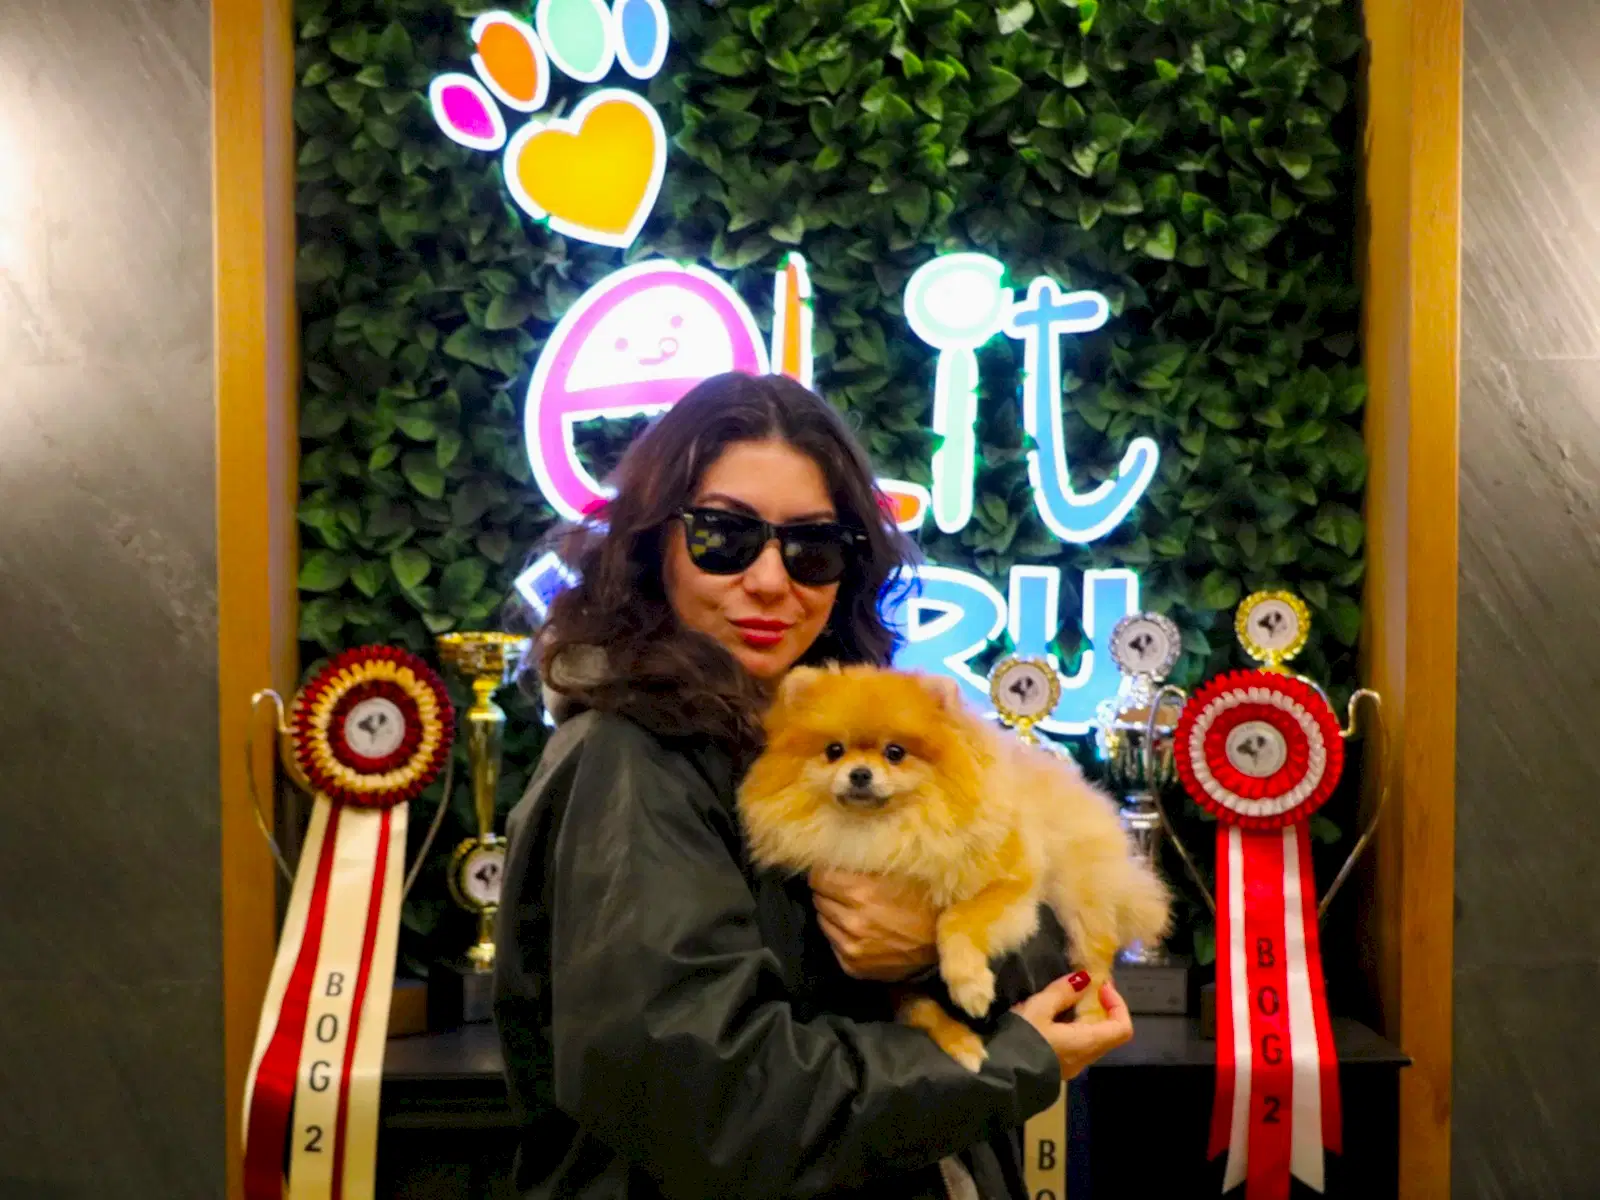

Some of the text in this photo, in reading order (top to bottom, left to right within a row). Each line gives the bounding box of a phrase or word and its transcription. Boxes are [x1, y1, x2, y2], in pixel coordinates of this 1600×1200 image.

[303, 971, 346, 1154] BOG 2
[1256, 936, 1283, 1125] BOG 2
